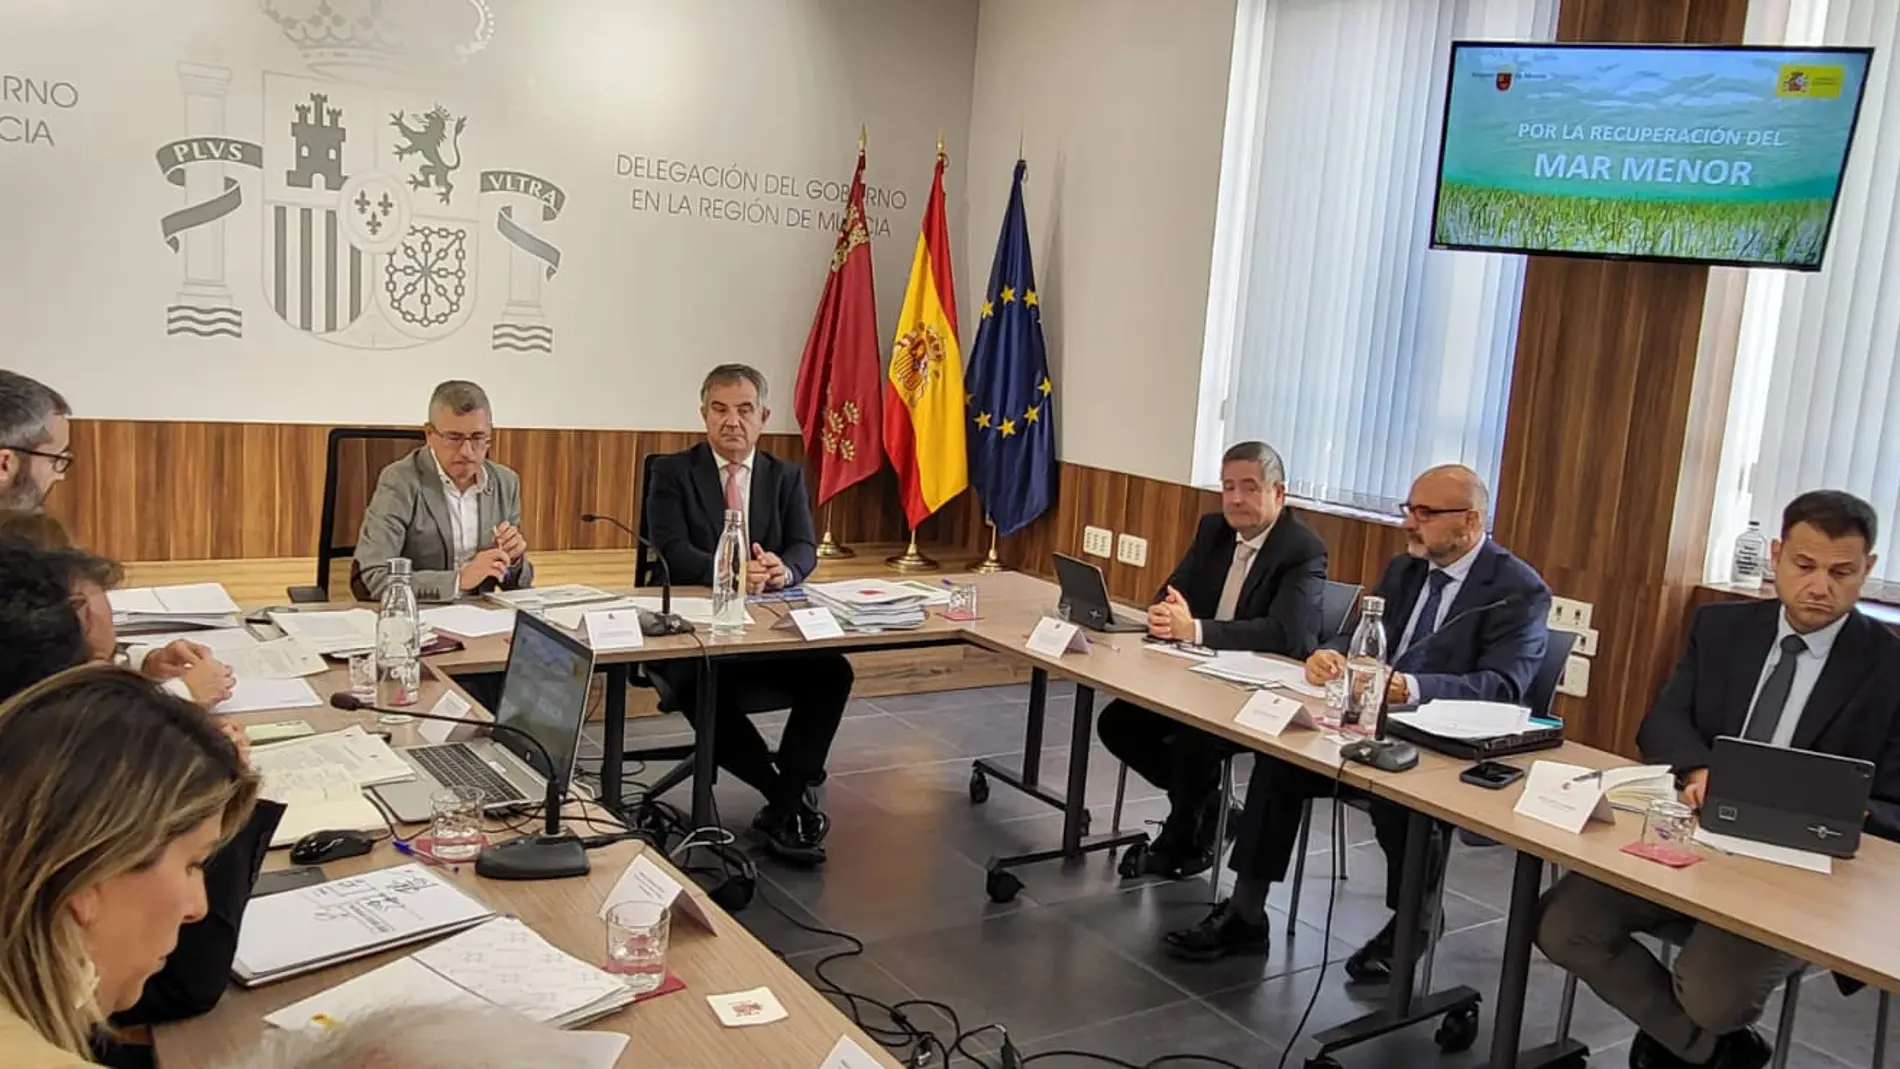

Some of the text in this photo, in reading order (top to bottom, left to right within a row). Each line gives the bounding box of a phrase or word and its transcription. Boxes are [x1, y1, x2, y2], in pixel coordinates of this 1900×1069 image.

[173, 141, 243, 162] PLVS
[1518, 123, 1785, 147] POR LA RECUPERACIÓN DEL
[616, 153, 908, 210] DELEGACIÓN DEL GOBRNO
[1534, 153, 1753, 186] MAR MENOR
[488, 174, 557, 208] VLTRA
[632, 188, 661, 213] EN
[667, 192, 693, 217] LA
[699, 196, 780, 226] REGIÓN
[786, 207, 812, 229] DE
